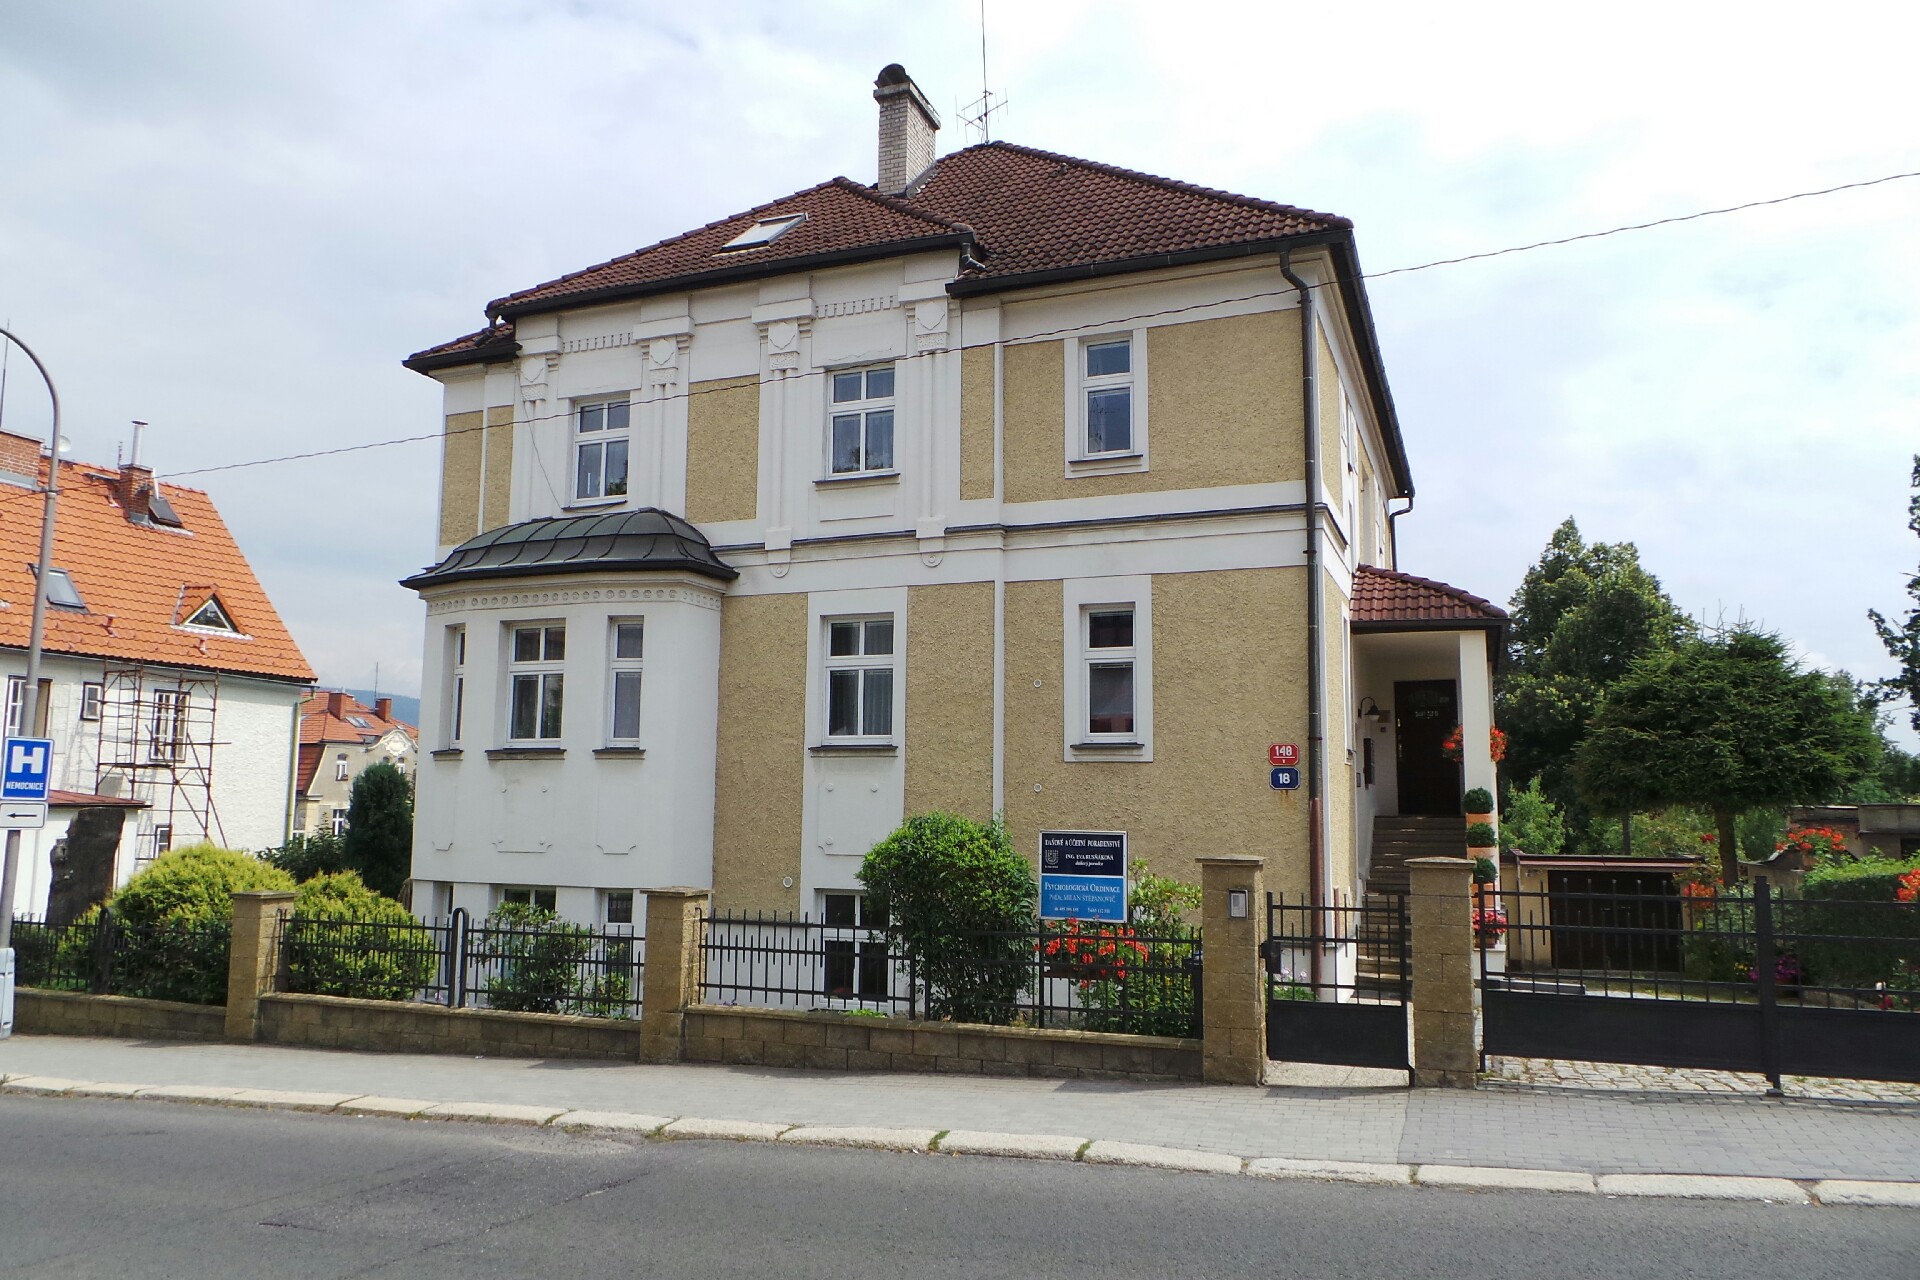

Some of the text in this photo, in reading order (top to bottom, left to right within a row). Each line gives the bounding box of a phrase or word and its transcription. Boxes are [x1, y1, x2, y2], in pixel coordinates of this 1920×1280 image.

[1275, 745, 1292, 756] 148
[11, 745, 45, 773] H
[1278, 772, 1291, 784] 18
[6, 781, 44, 790] NEMOCNICE
[1087, 839, 1120, 848] PORADENSTVÍ
